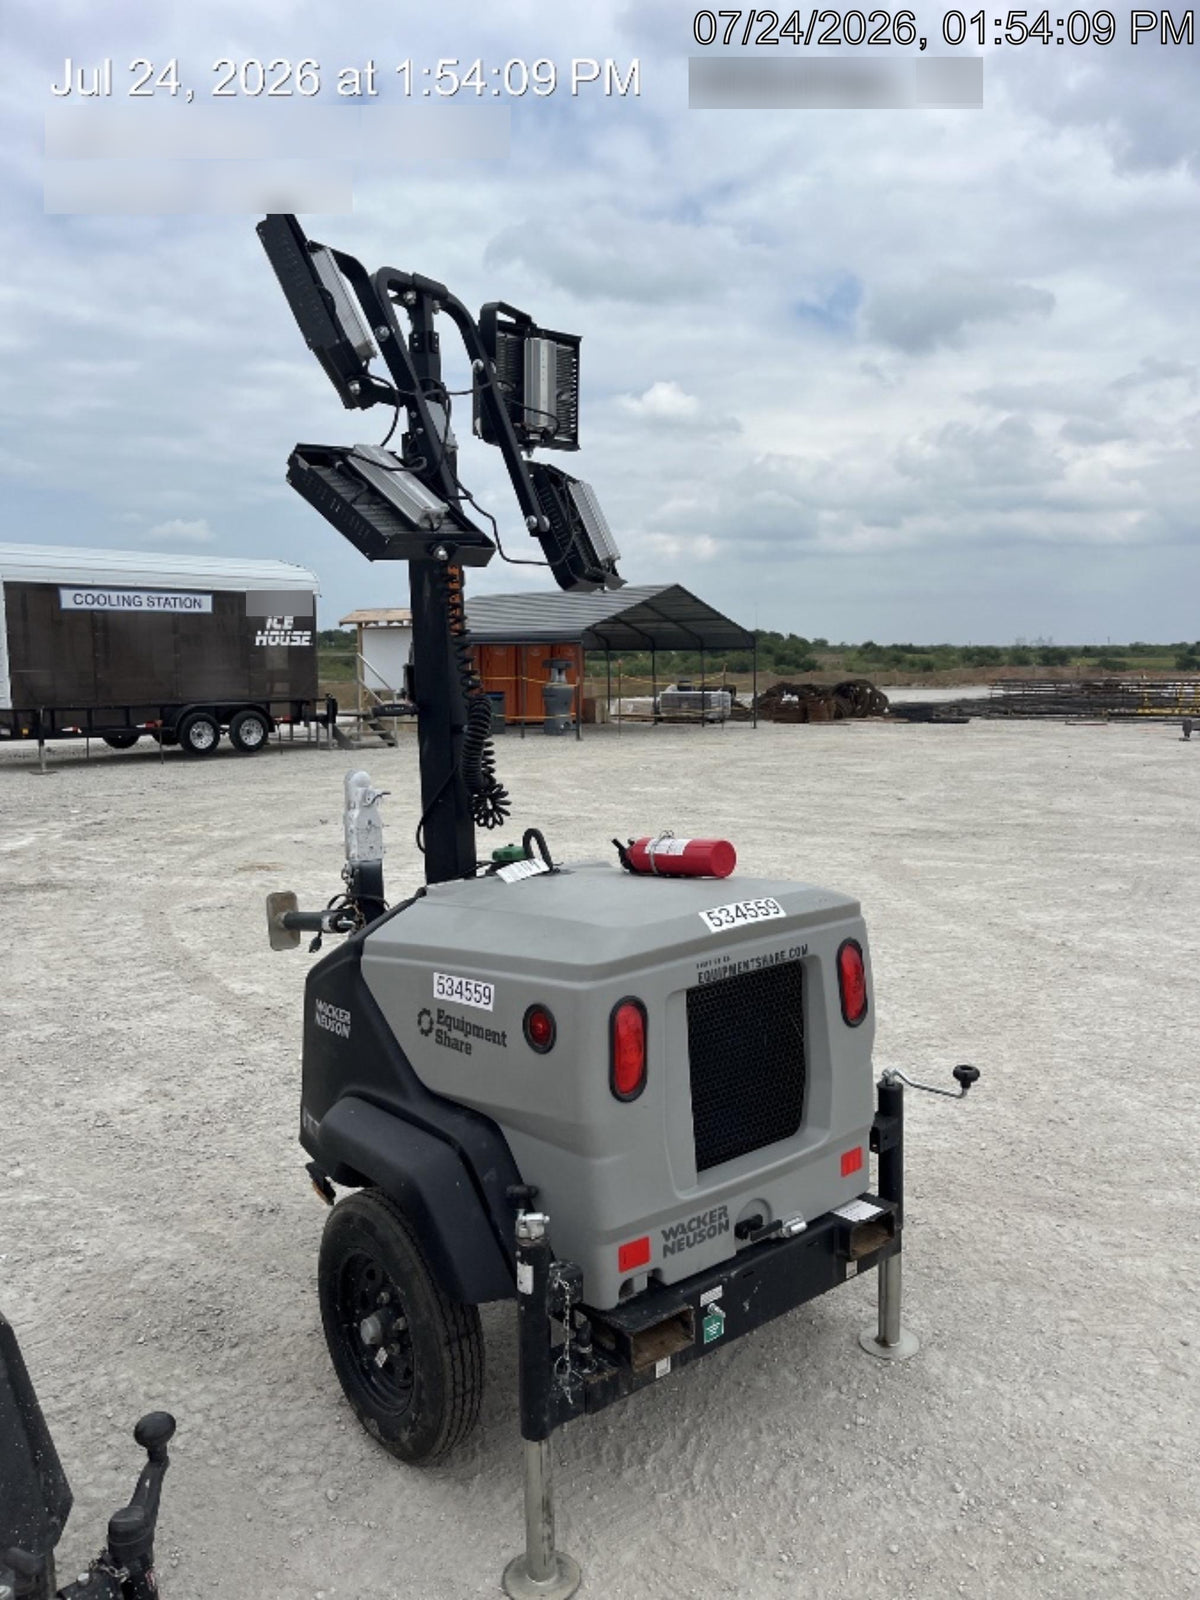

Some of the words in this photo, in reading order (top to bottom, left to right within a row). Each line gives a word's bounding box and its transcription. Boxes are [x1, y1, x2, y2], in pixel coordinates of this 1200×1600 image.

[73, 593, 143, 607] COOLING
[146, 595, 203, 609] STATION
[266, 615, 294, 630] ICE
[707, 898, 781, 928] 534559
[698, 943, 808, 984] EQUIPMENTSHARE.COM
[436, 975, 492, 1006] 534559
[315, 998, 351, 1025] WACKER
[315, 1011, 351, 1039] NEUSON
[435, 1029, 473, 1055] Share
[436, 1008, 508, 1047] Equipment
[661, 1205, 729, 1242] WACKER
[662, 1221, 730, 1258] NEUSON
